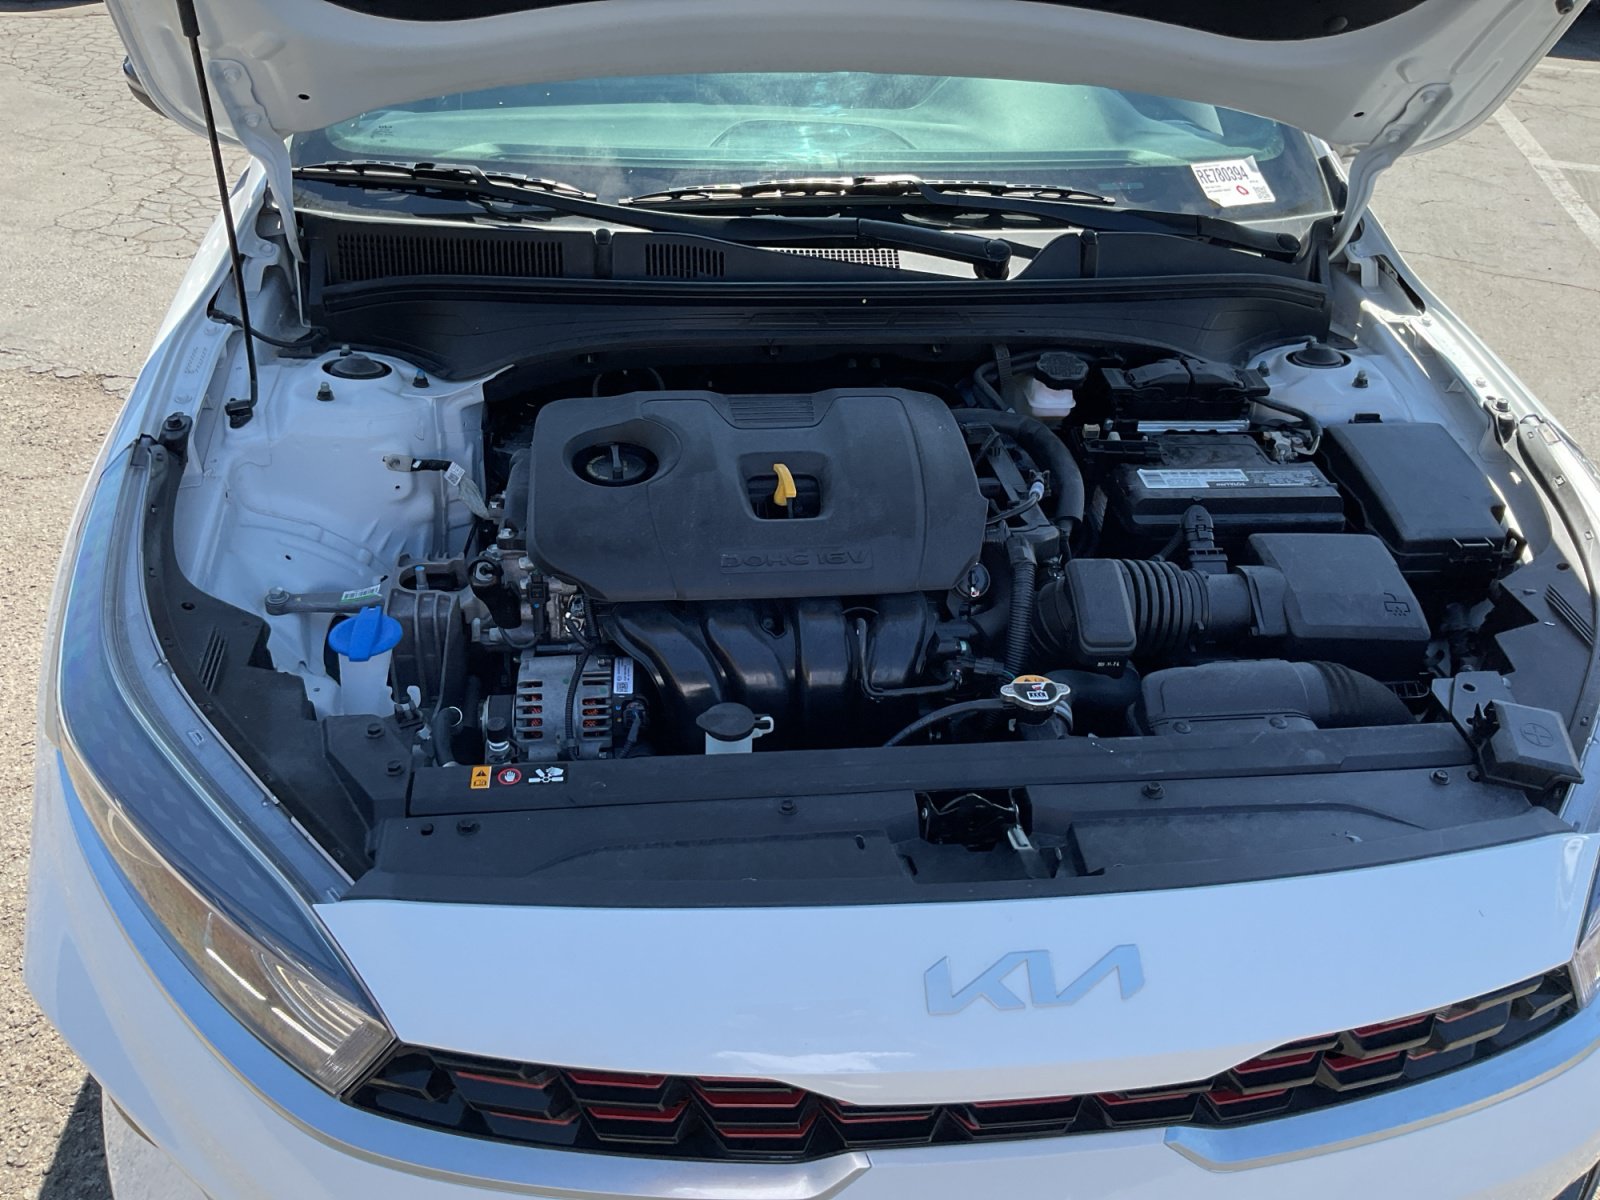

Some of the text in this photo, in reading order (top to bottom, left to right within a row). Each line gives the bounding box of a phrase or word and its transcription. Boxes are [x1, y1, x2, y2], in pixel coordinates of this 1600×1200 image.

[1196, 166, 1249, 184] RE780394
[720, 552, 811, 568] DOHC
[923, 943, 1146, 1016] KIA
